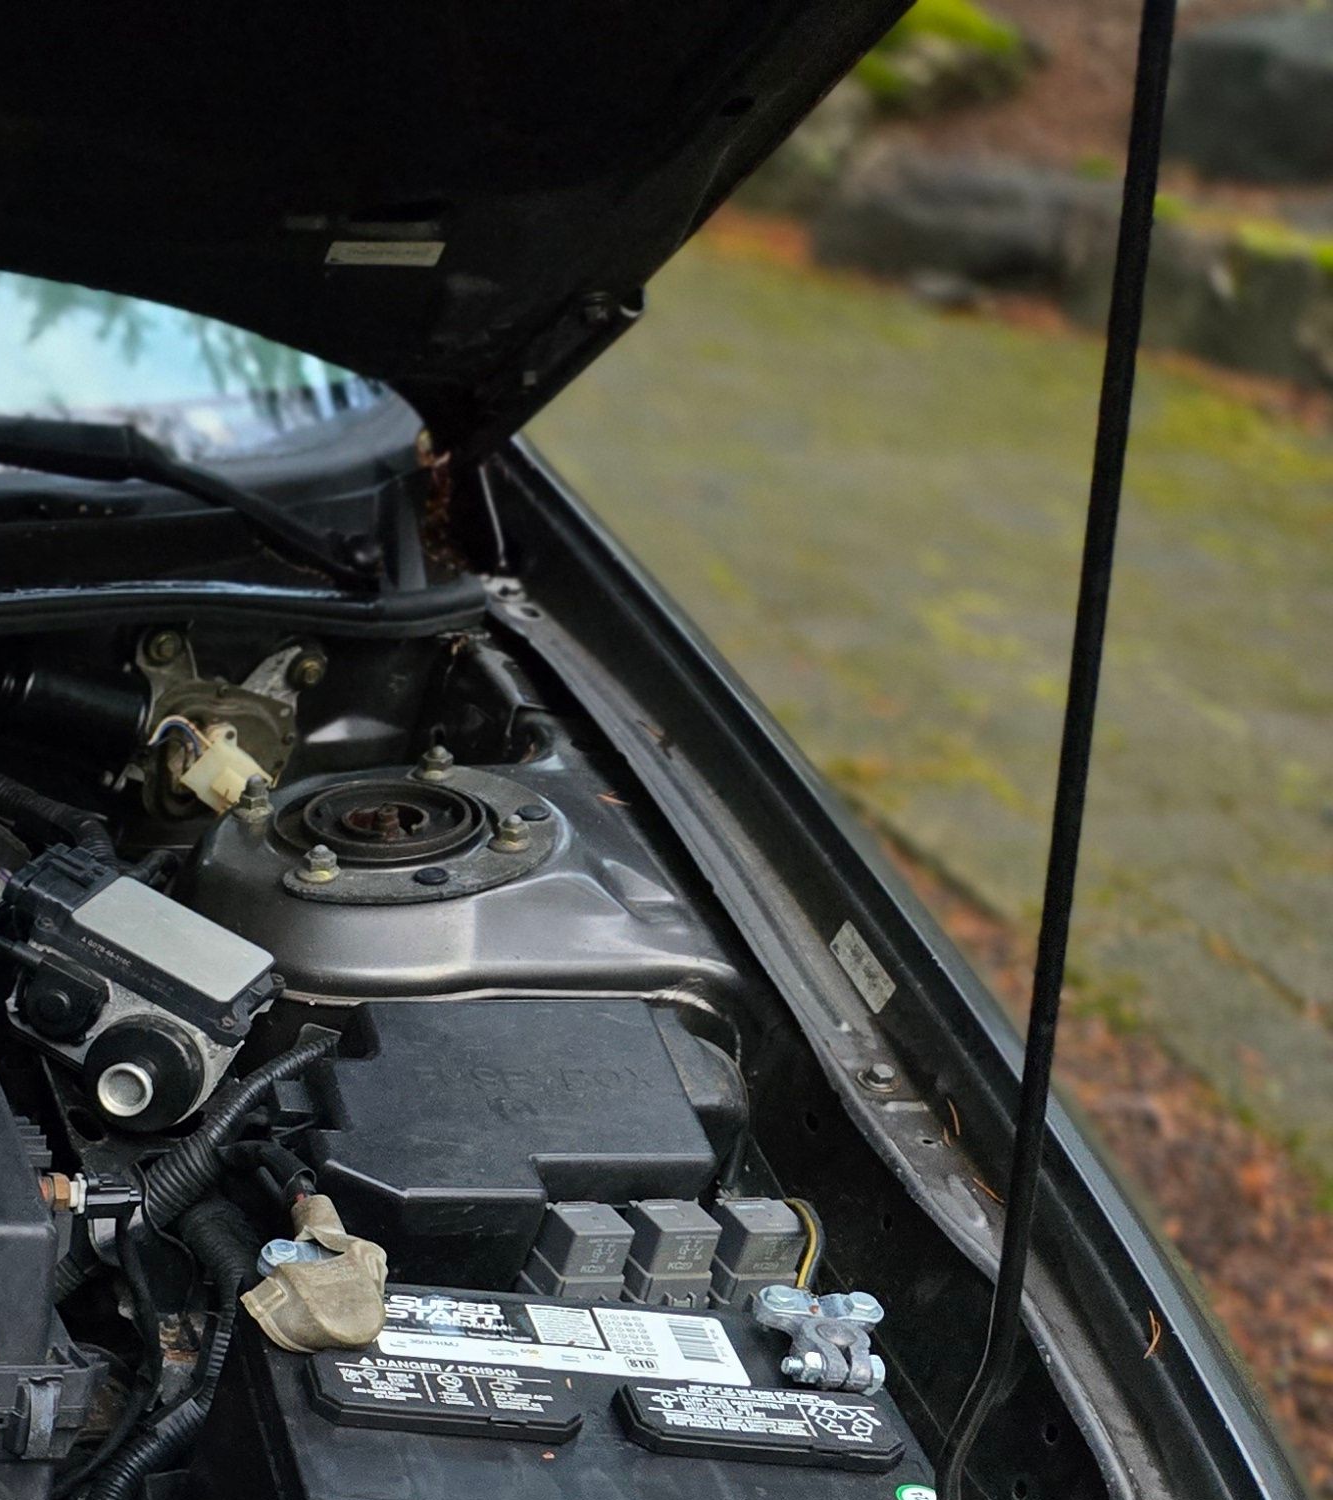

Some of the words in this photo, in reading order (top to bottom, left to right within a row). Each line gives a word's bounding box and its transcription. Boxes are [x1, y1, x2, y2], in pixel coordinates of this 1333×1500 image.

[385, 1304, 505, 1325] START
[389, 1295, 502, 1315] SUPER
[376, 1358, 441, 1372] DANGER
[458, 1365, 518, 1378] POISON
